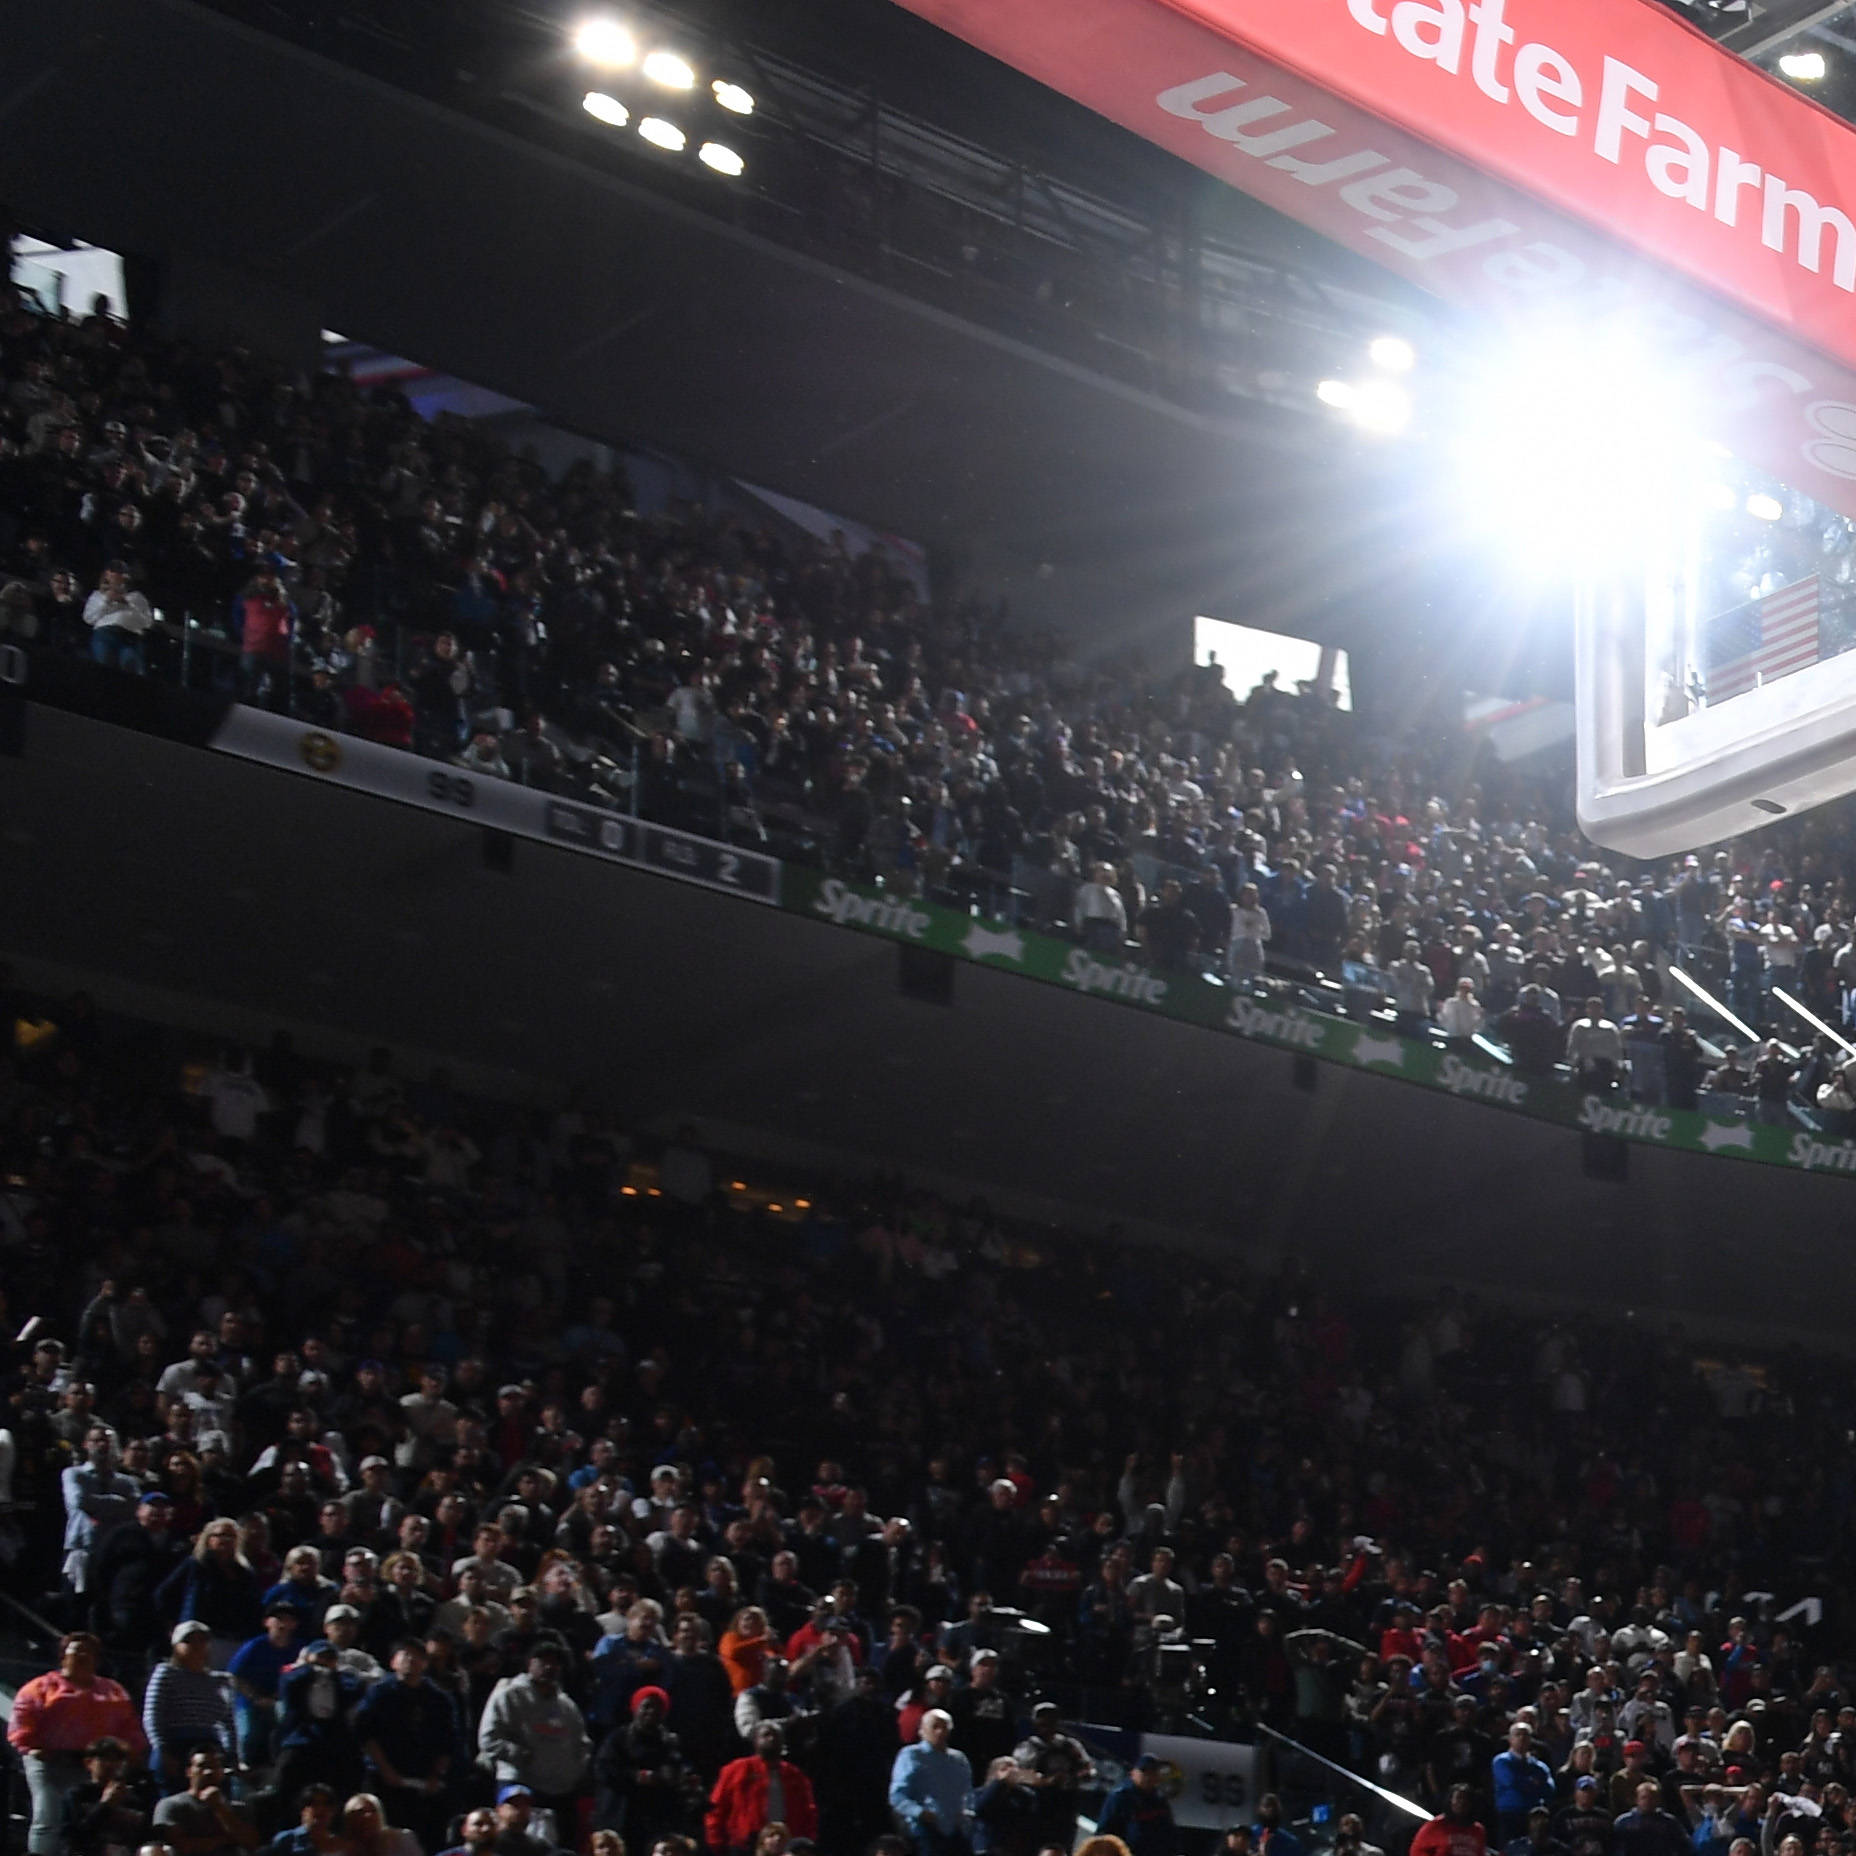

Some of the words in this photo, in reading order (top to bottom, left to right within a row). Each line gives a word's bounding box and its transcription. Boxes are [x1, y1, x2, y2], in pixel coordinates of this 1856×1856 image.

[1345, 0, 1582, 136] ate
[816, 878, 931, 939] Sprite
[1062, 947, 1168, 1005] Sprite
[1226, 996, 1325, 1050] Sprite
[1436, 1052, 1529, 1105] Sprite
[1579, 1095, 1673, 1141] Sprite
